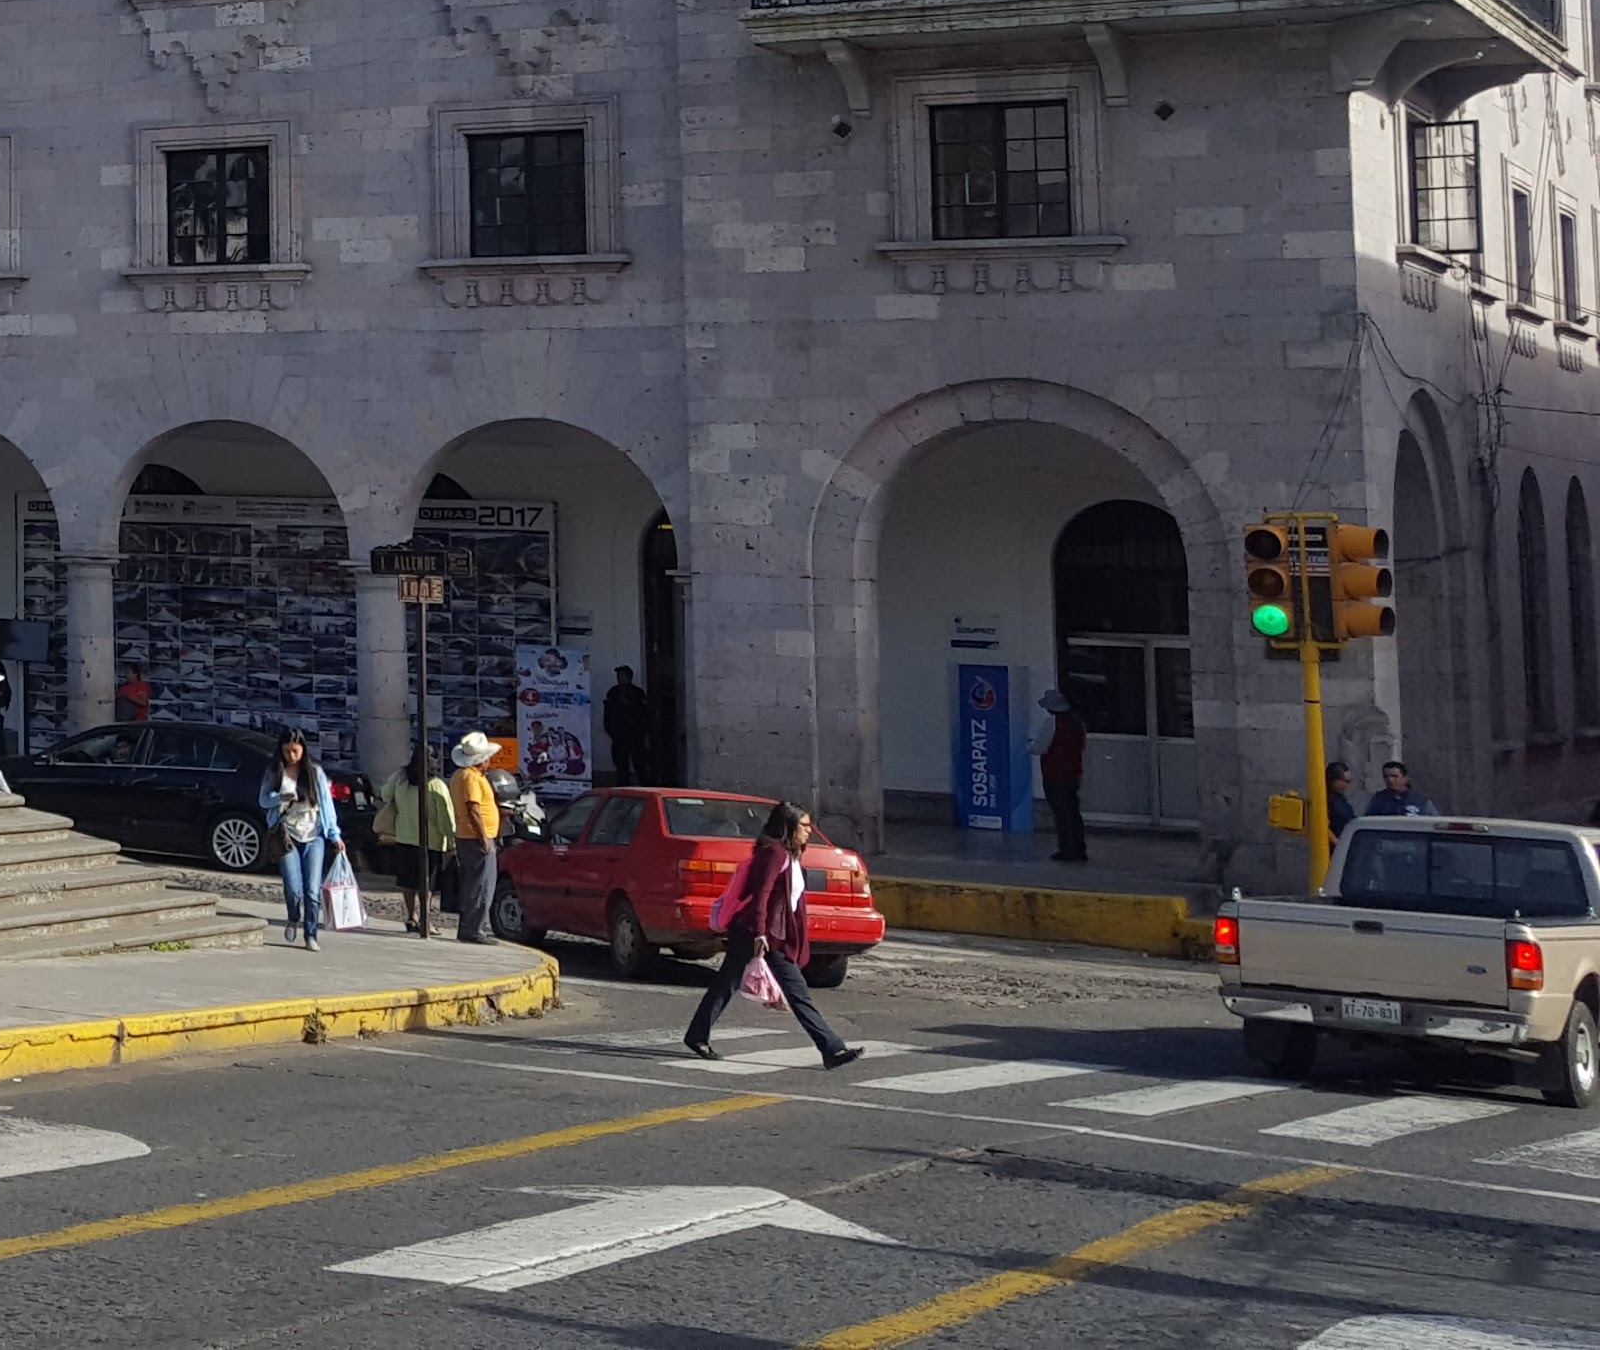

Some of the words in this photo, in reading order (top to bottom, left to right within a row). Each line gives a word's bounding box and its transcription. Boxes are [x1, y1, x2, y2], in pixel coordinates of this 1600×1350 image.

[420, 508, 476, 520] OBRAS
[478, 506, 544, 527] 2017
[393, 555, 437, 571] ALLENDE
[970, 718, 988, 808] SOSAPATZ
